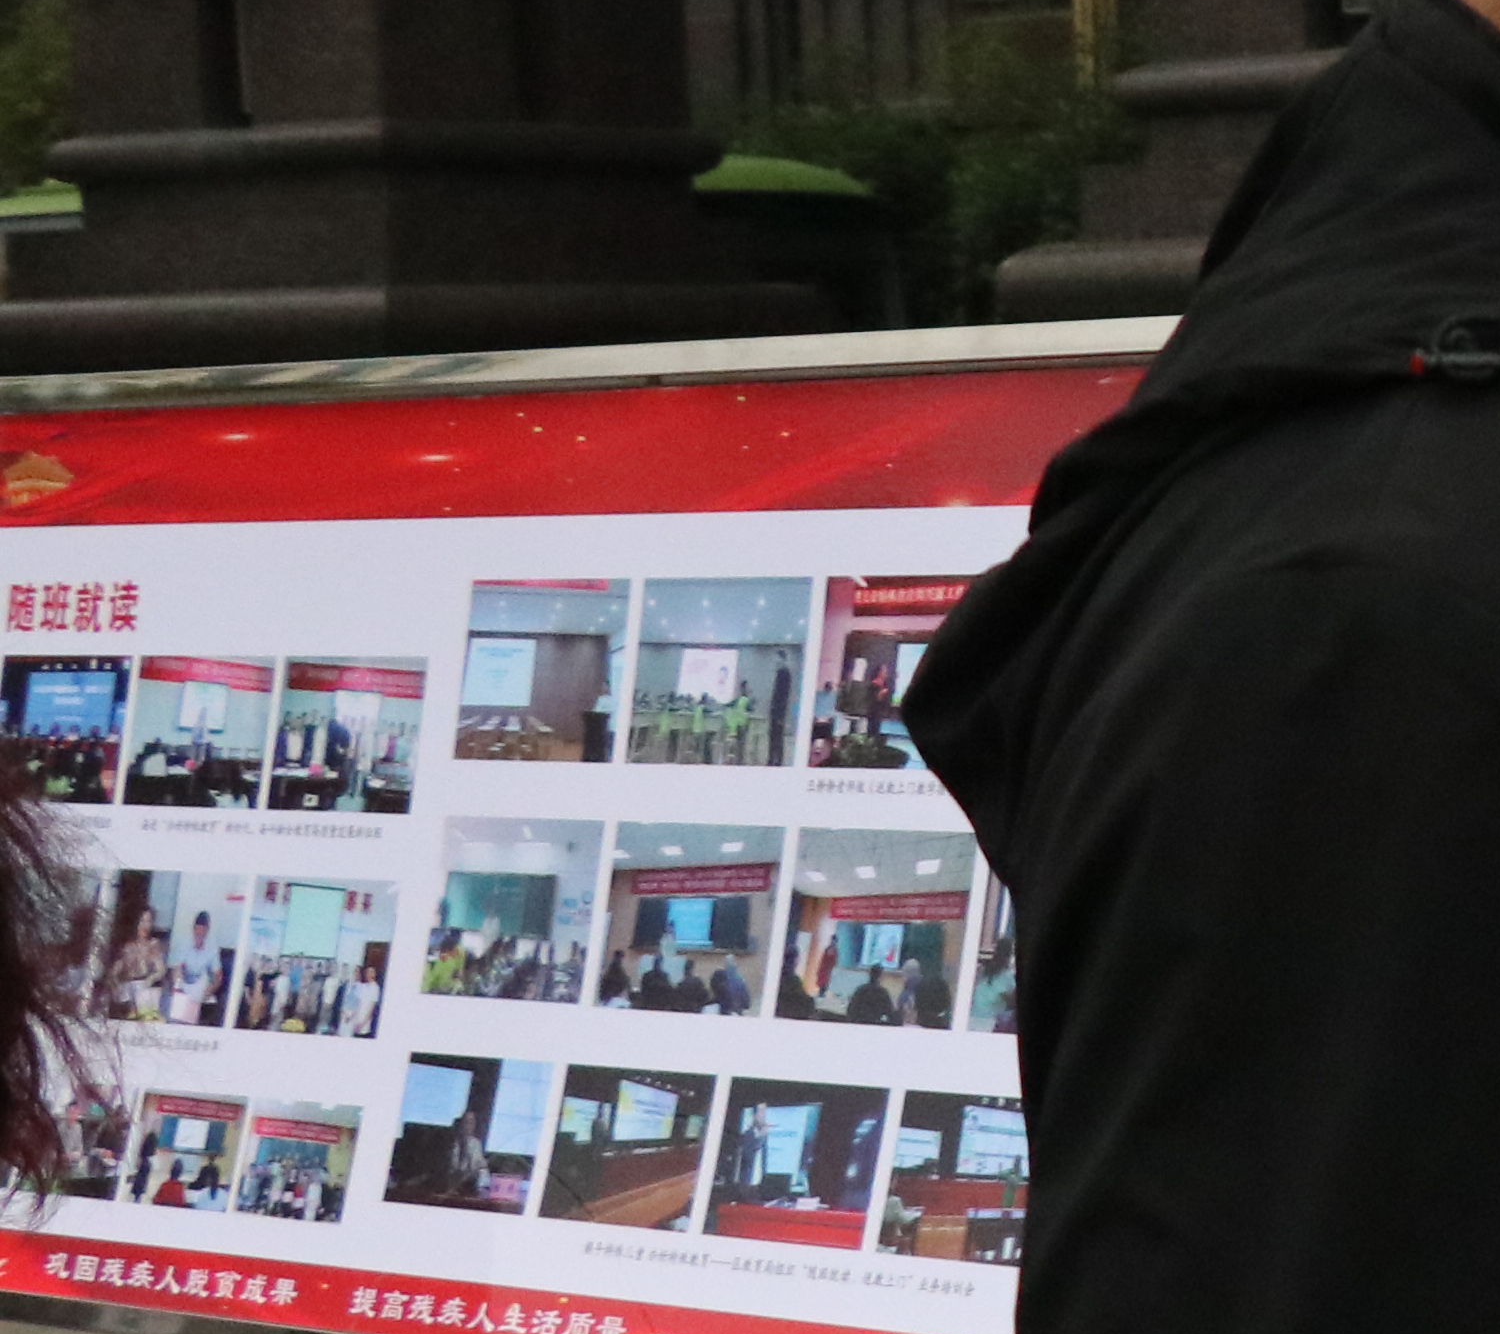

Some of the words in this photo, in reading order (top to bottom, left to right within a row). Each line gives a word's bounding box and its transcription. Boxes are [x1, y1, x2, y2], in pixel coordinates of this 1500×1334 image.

[7, 580, 140, 633] 随班就读
[43, 1252, 299, 1307] 巩固残疾人脱贫成果
